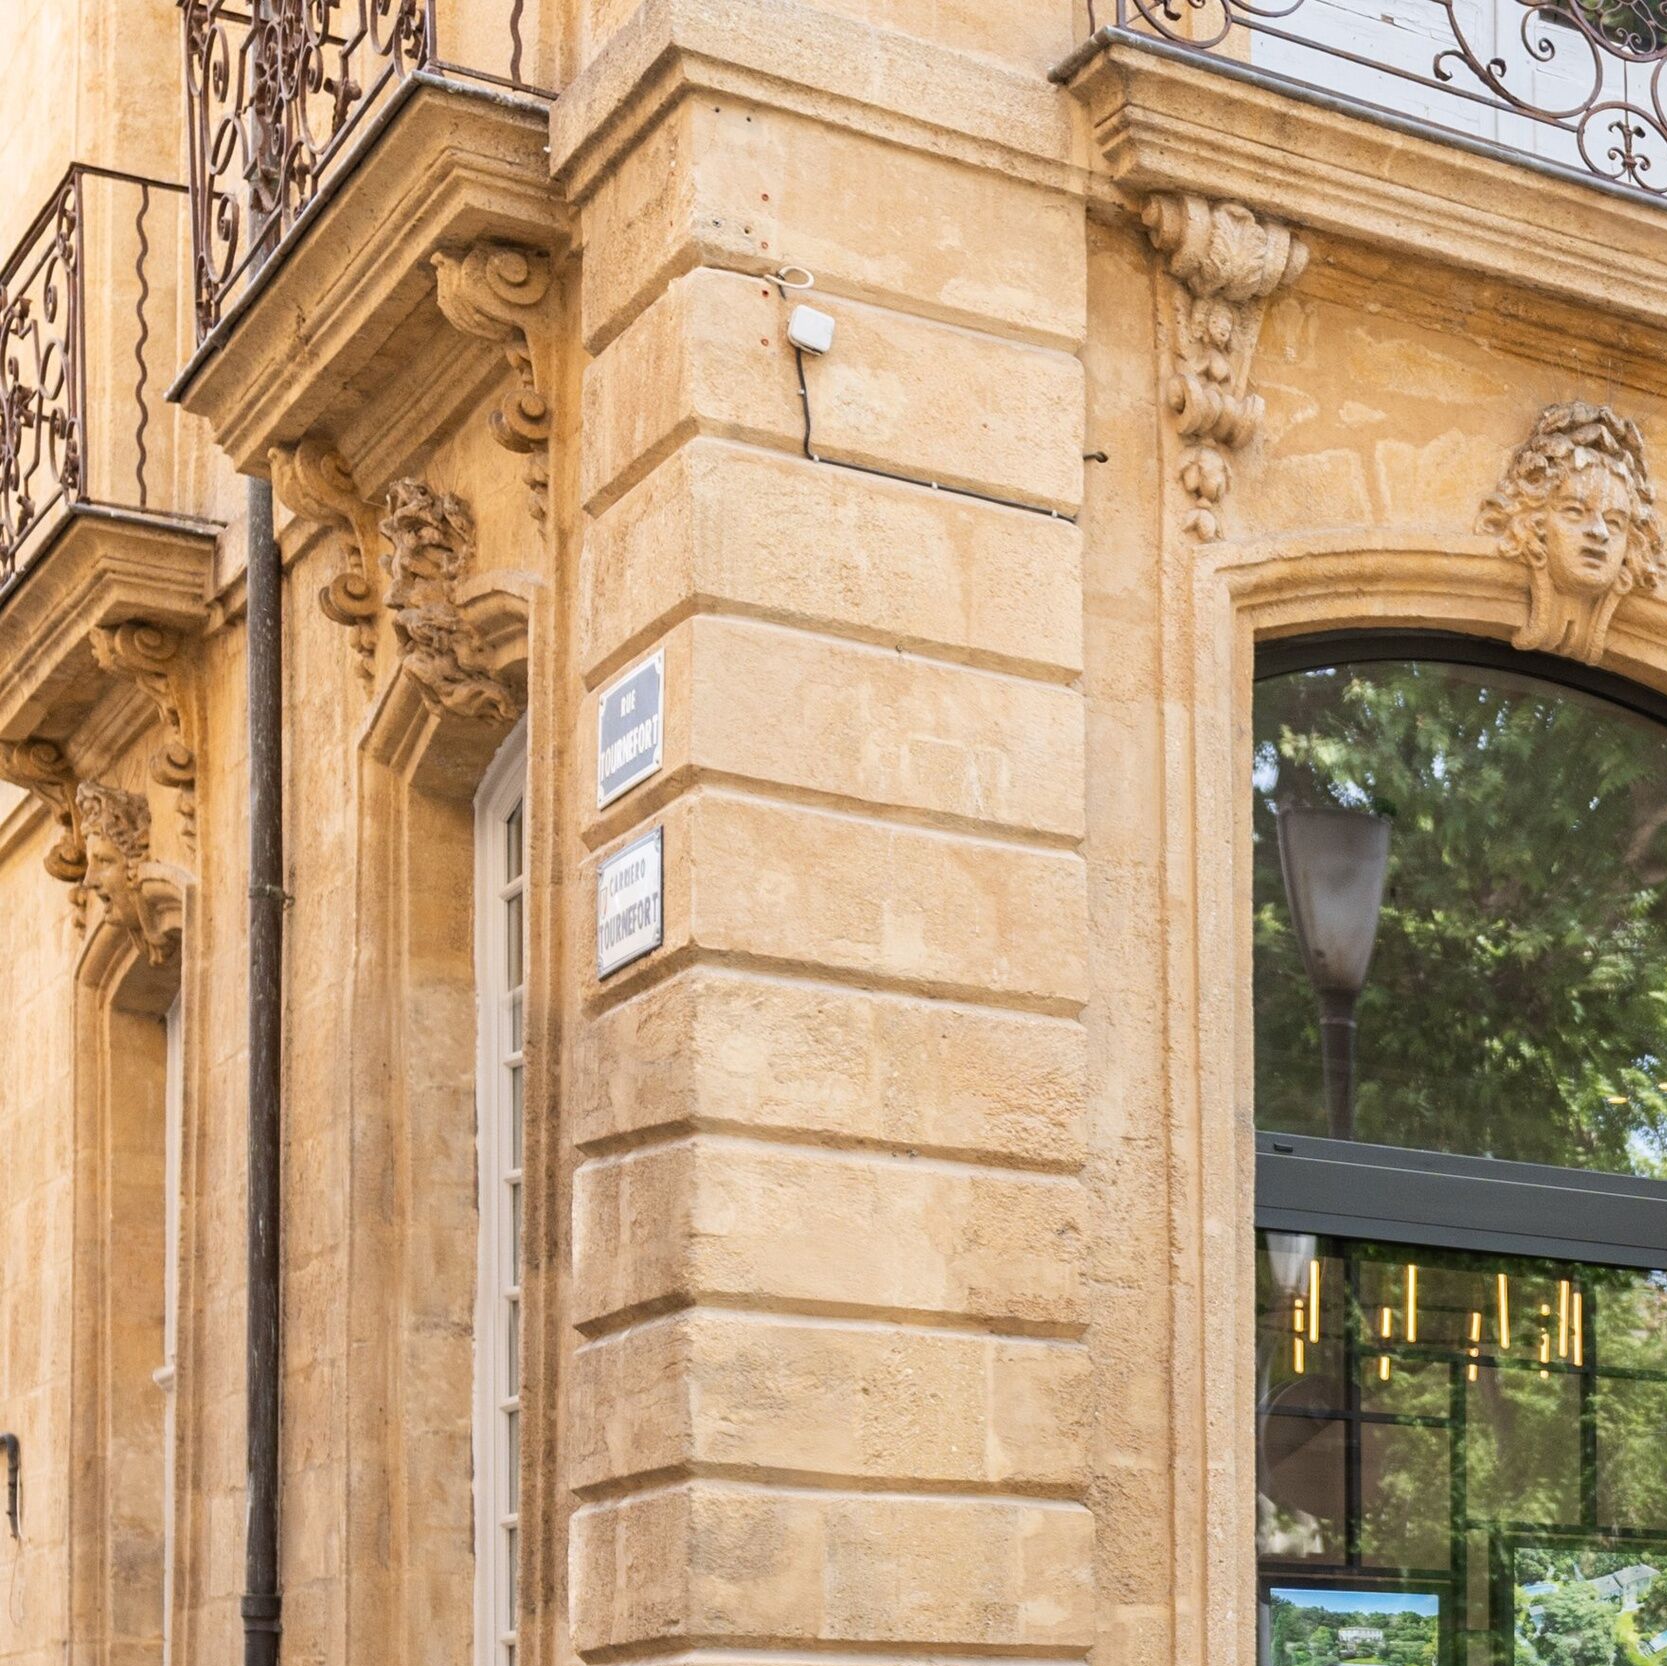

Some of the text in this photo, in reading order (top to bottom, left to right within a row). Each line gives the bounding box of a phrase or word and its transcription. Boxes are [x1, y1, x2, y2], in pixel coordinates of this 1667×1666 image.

[620, 689, 636, 718] RUE
[601, 713, 659, 781] TOURNEFORT
[609, 858, 646, 897] CARRIERO
[600, 892, 659, 954] TOURNEFORT
